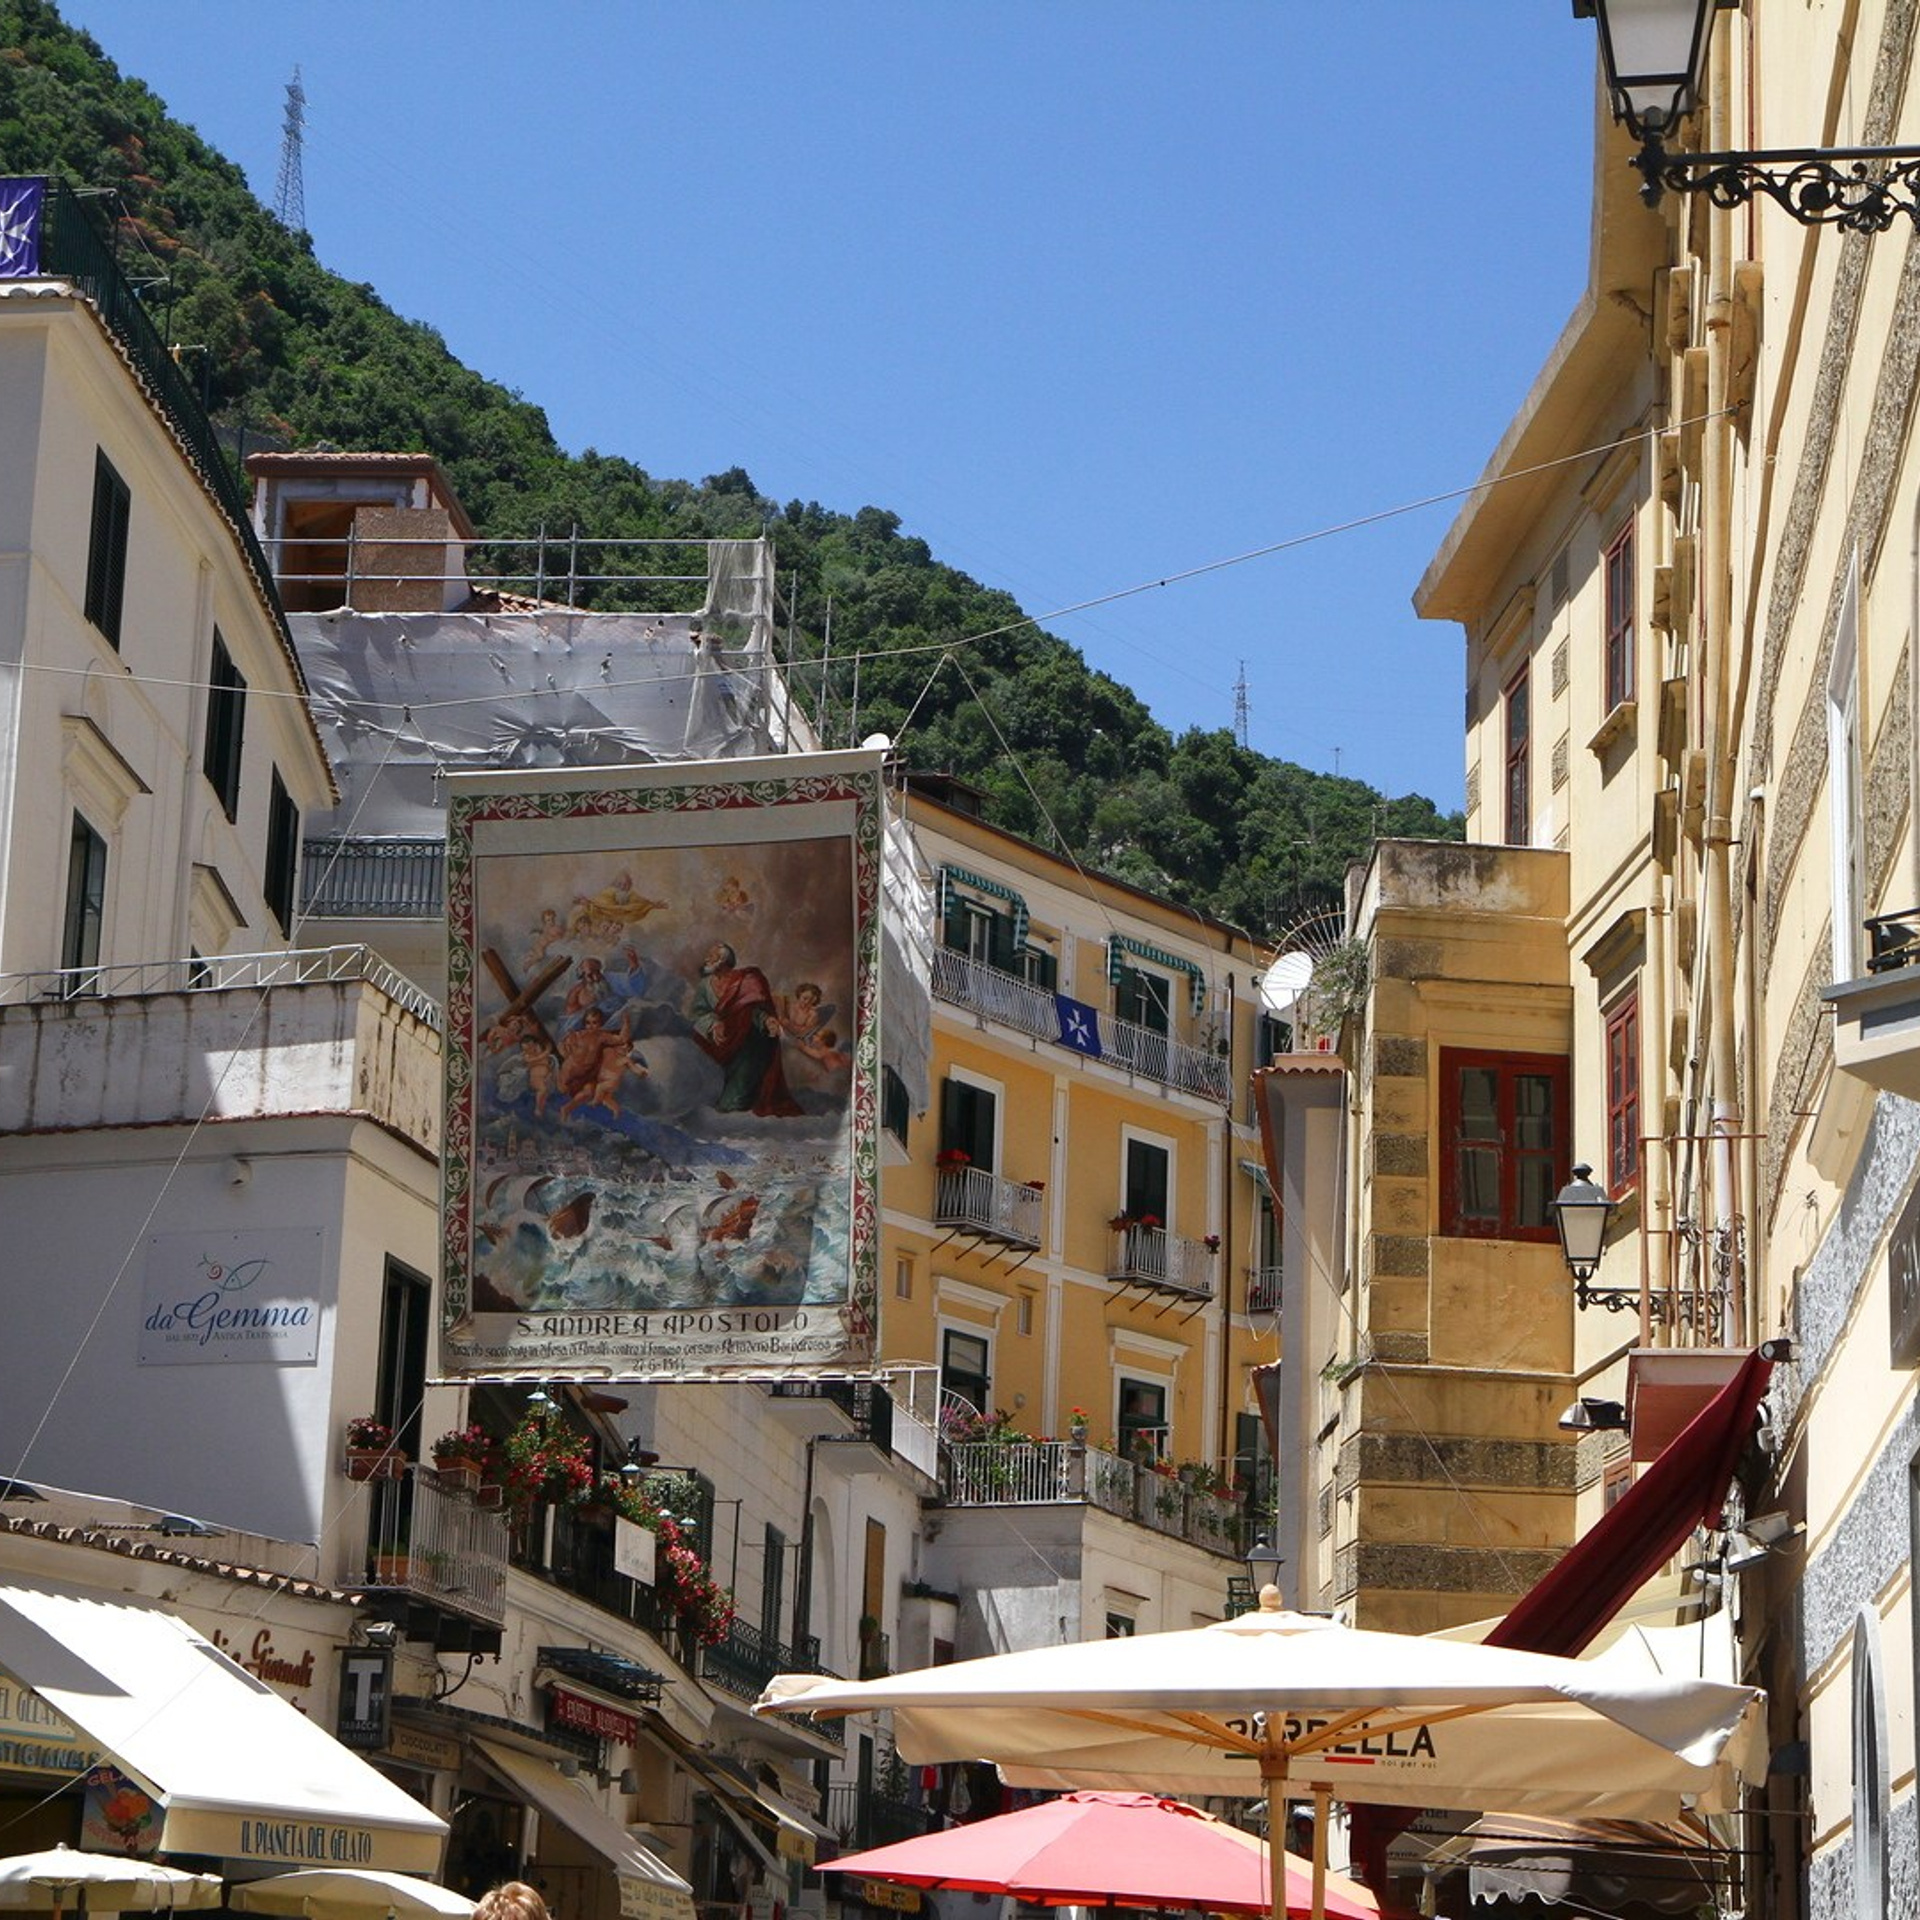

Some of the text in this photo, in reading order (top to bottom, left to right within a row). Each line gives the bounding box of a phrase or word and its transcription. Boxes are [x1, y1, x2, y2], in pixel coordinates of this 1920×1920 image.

[145, 1291, 313, 1346] da Gemma
[347, 1659, 383, 1721] T
[1400, 1761, 1416, 1769] per
[242, 1820, 372, 1864] IL PIANETA DEL GELATO
